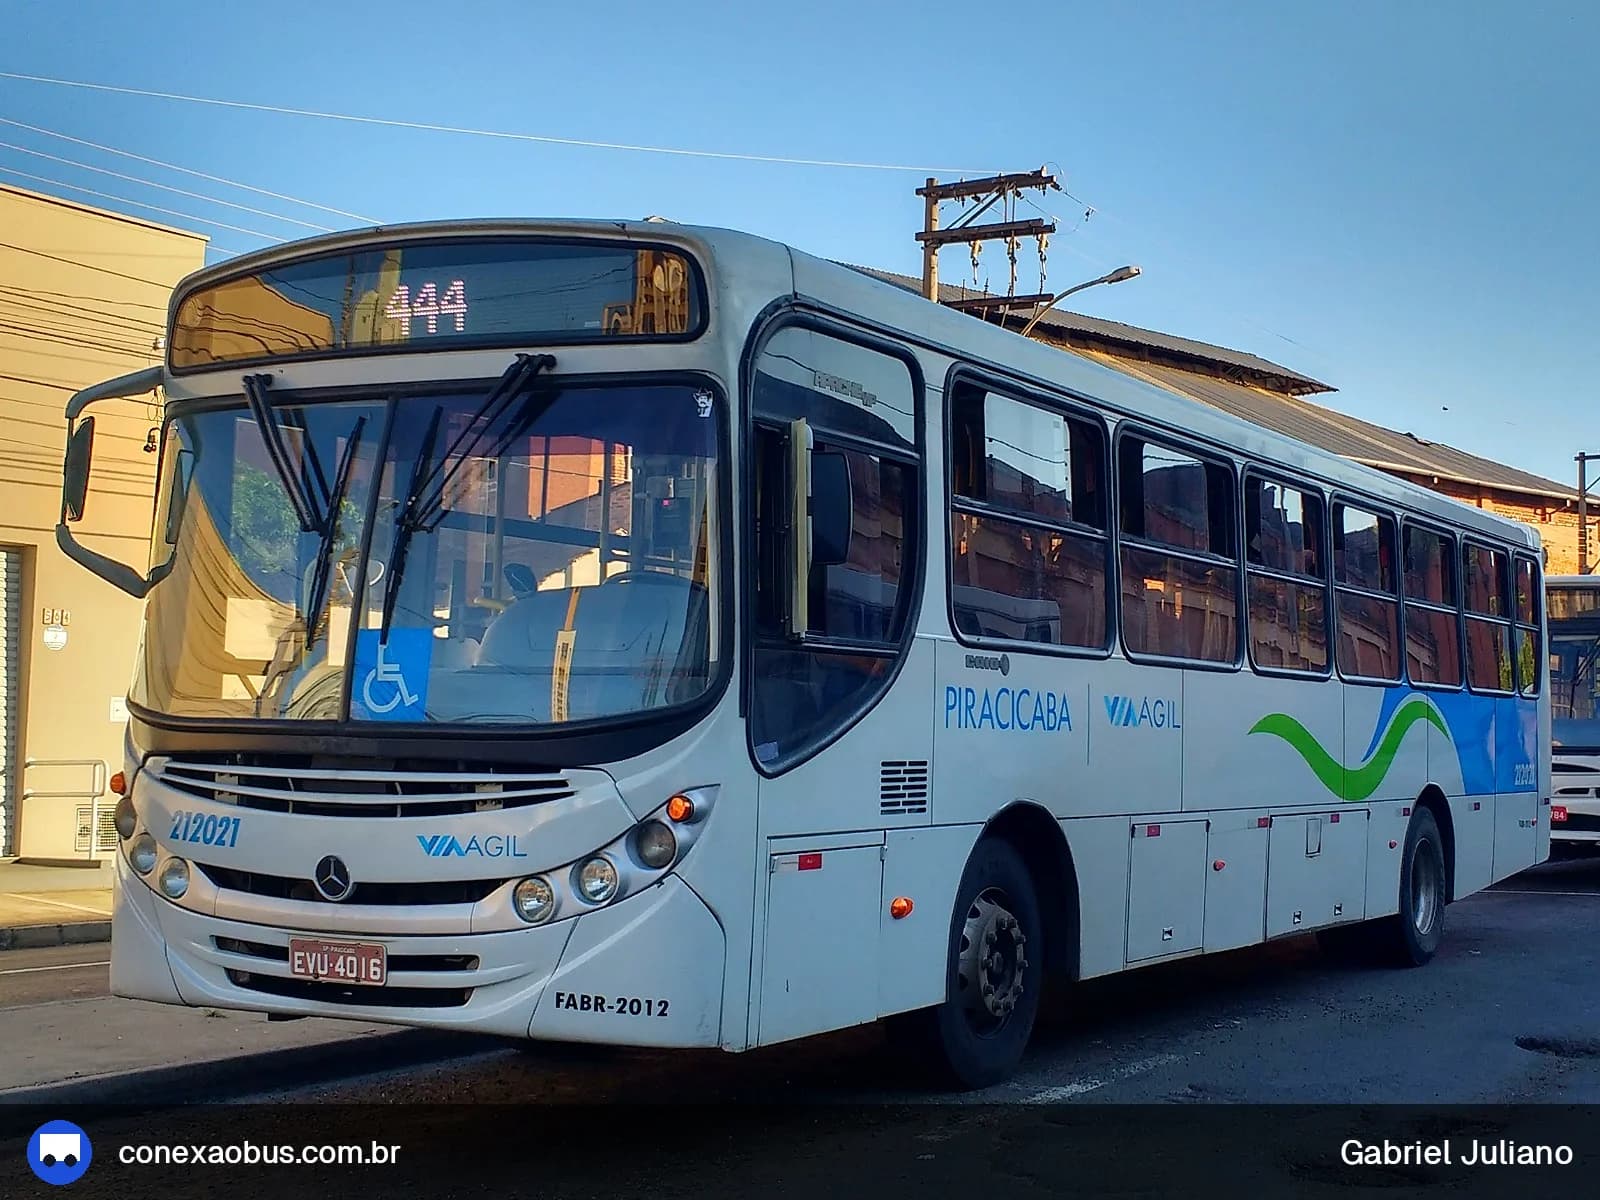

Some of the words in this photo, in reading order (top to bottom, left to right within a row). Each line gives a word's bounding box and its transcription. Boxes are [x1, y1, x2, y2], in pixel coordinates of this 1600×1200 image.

[385, 280, 467, 335] 444
[945, 685, 1073, 732] PIRACICABA
[169, 810, 242, 848] 212021
[555, 991, 670, 1017] FABR-2012
